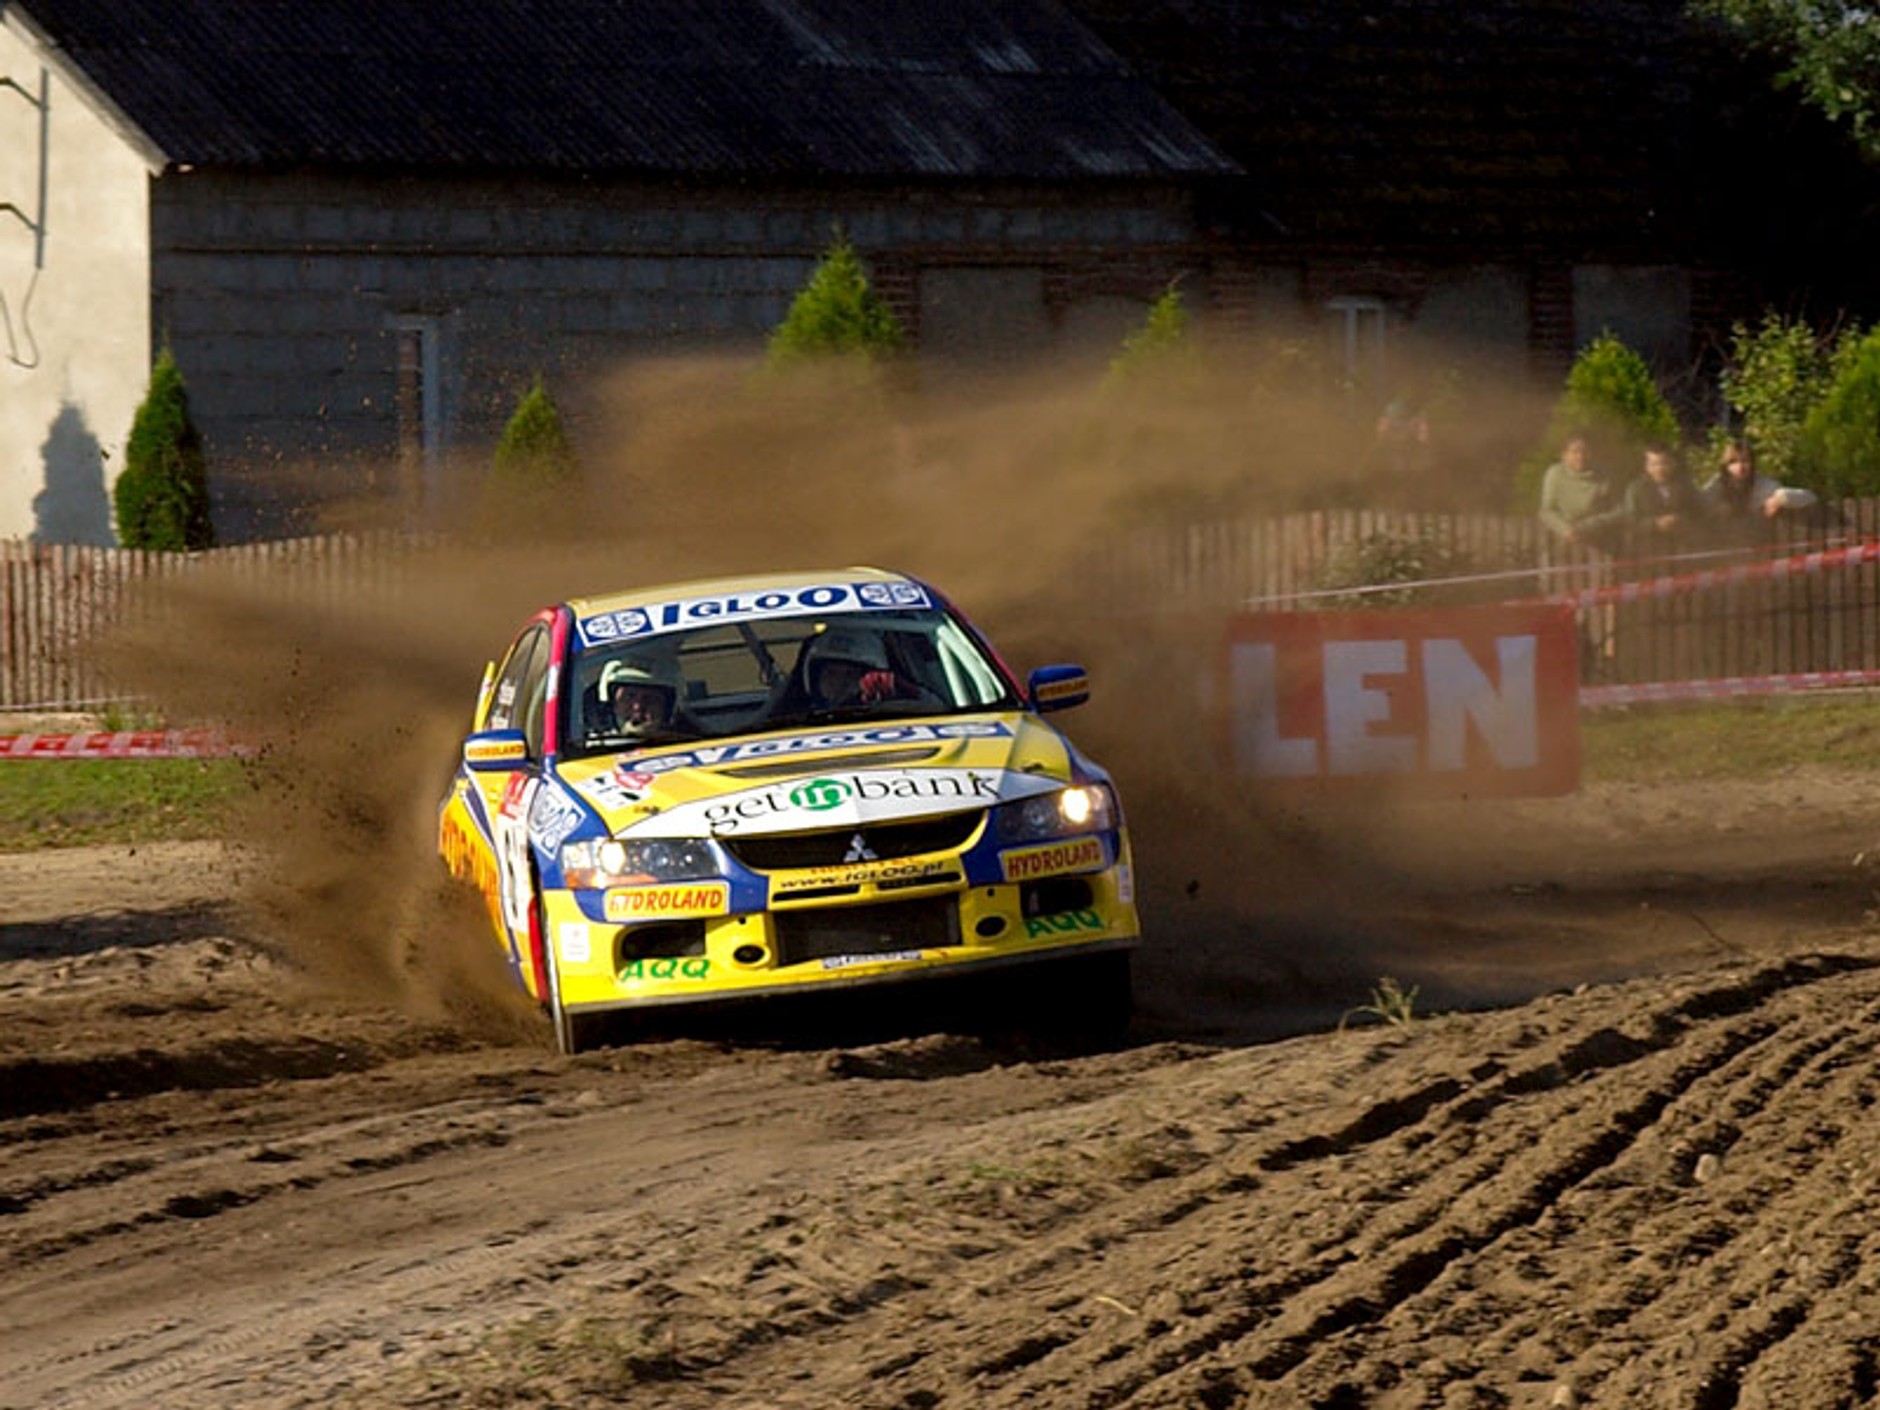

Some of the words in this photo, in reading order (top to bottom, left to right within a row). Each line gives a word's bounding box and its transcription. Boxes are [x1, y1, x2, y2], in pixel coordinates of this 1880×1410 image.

[661, 586, 849, 627] IGLOO
[1231, 634, 1540, 777] LEN
[1007, 841, 1101, 879] HYDROLAND
[619, 958, 711, 983] AQQ
